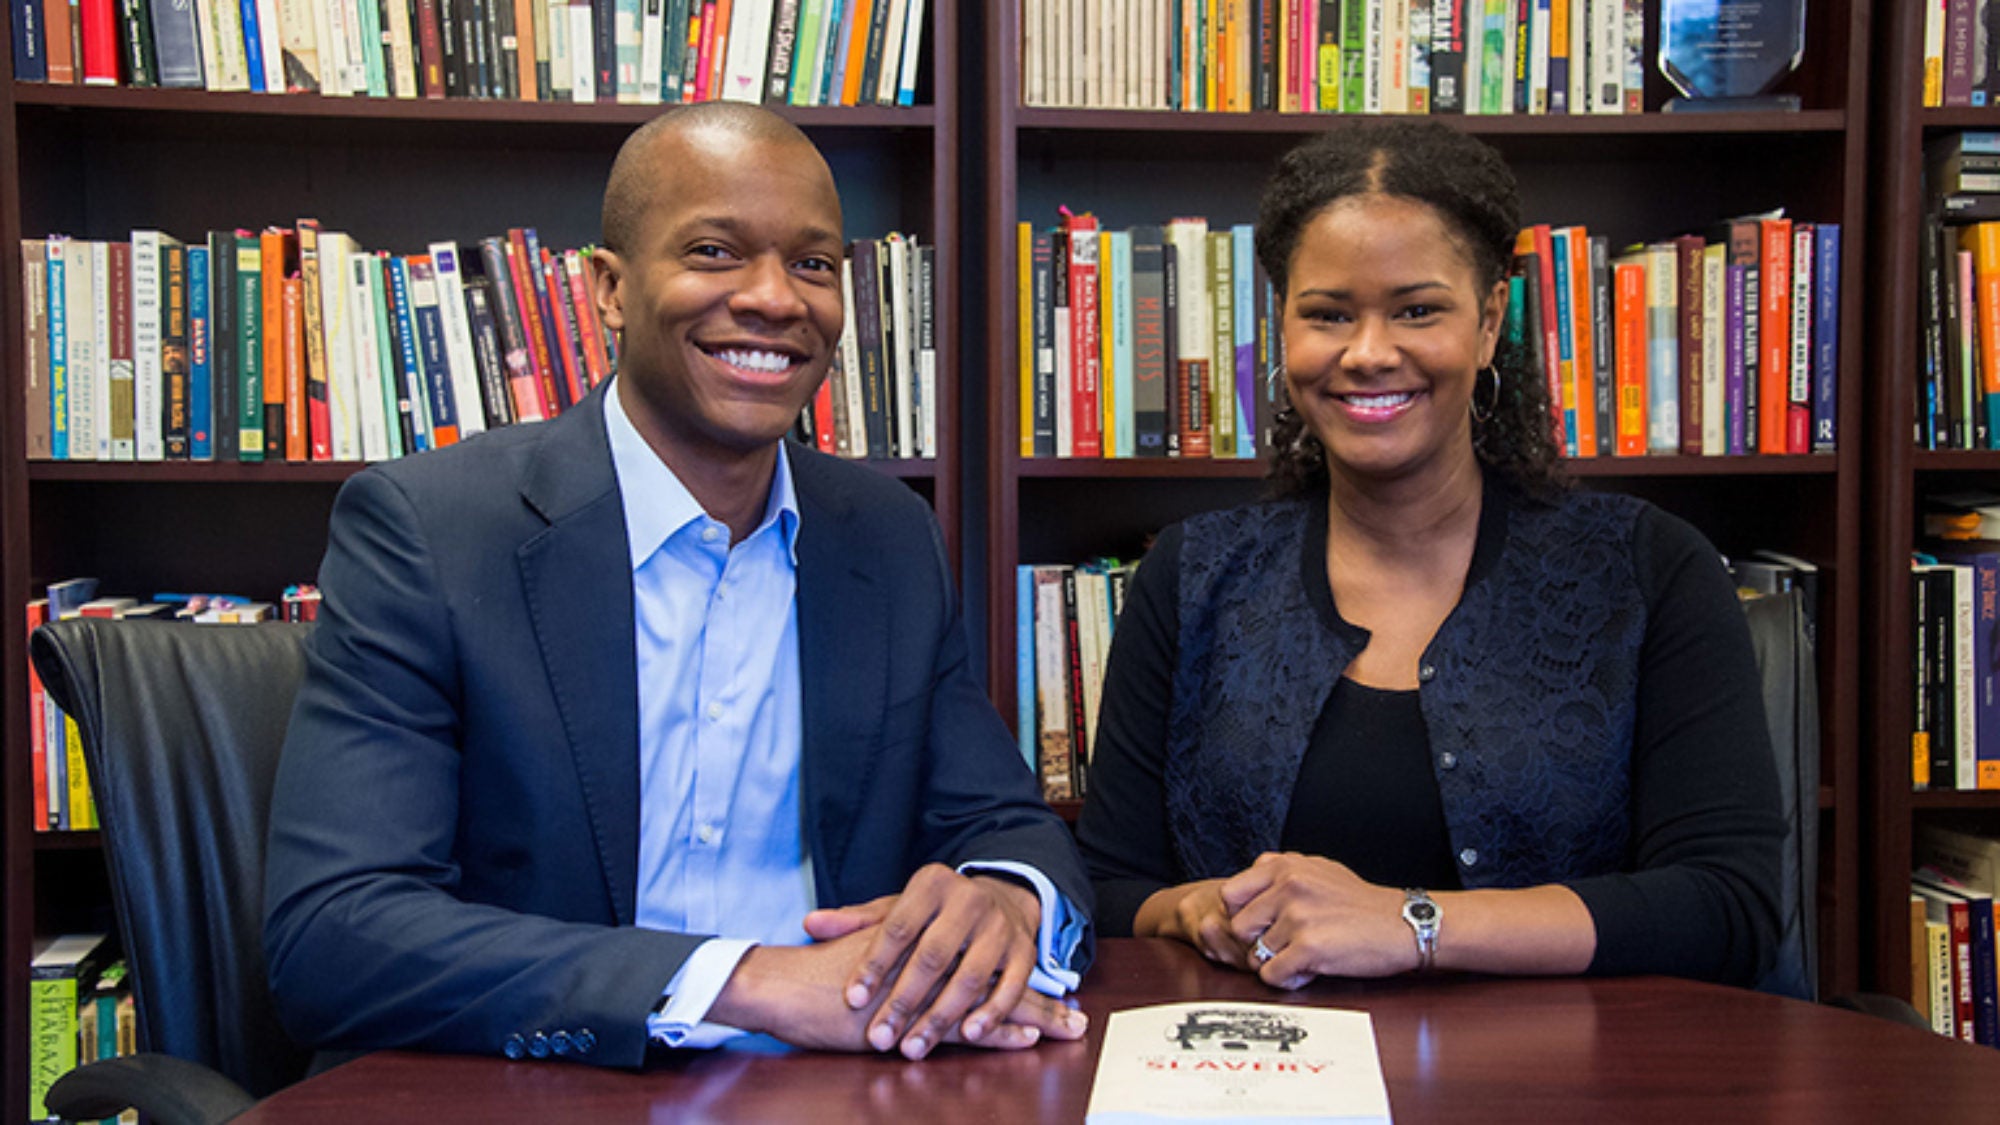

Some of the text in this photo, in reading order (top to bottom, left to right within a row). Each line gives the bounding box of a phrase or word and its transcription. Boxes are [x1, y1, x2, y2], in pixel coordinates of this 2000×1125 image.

[1952, 17, 1968, 78] EMPIRE
[138, 322, 157, 352] BOY
[1136, 297, 1162, 382] MIMESIS
[1959, 643, 1973, 666] and
[1145, 1059, 1328, 1074] SLAVERY
